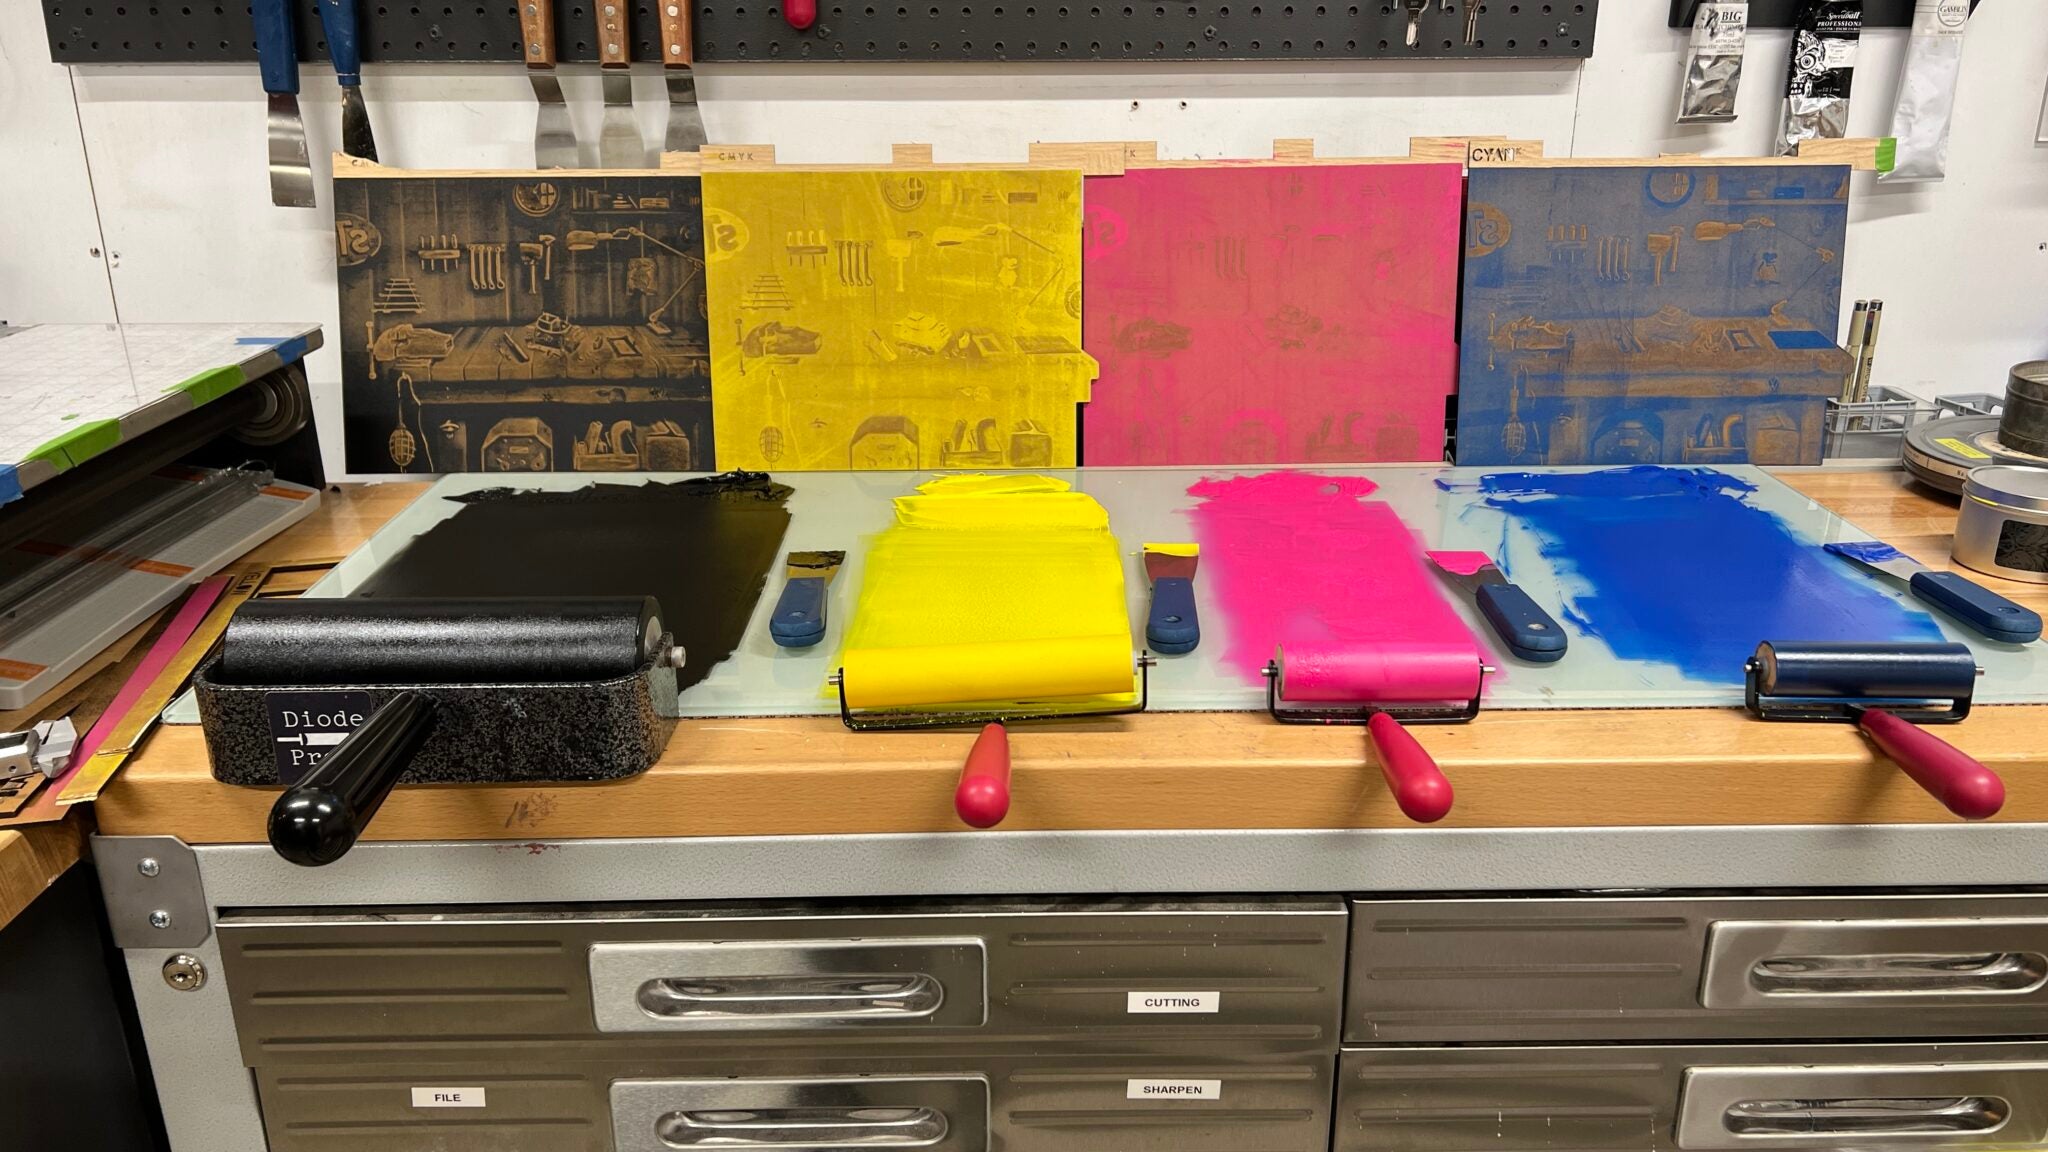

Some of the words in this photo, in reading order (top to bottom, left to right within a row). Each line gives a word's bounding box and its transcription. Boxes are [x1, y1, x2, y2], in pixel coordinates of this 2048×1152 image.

[1721, 11, 1743, 21] BIG
[718, 152, 754, 161] CMYK
[282, 711, 364, 728] Diode
[291, 750, 328, 766] Pr
[1144, 998, 1200, 1007] CUTTING
[1143, 1085, 1202, 1094] SHARPEN
[434, 1094, 461, 1102] FILE
